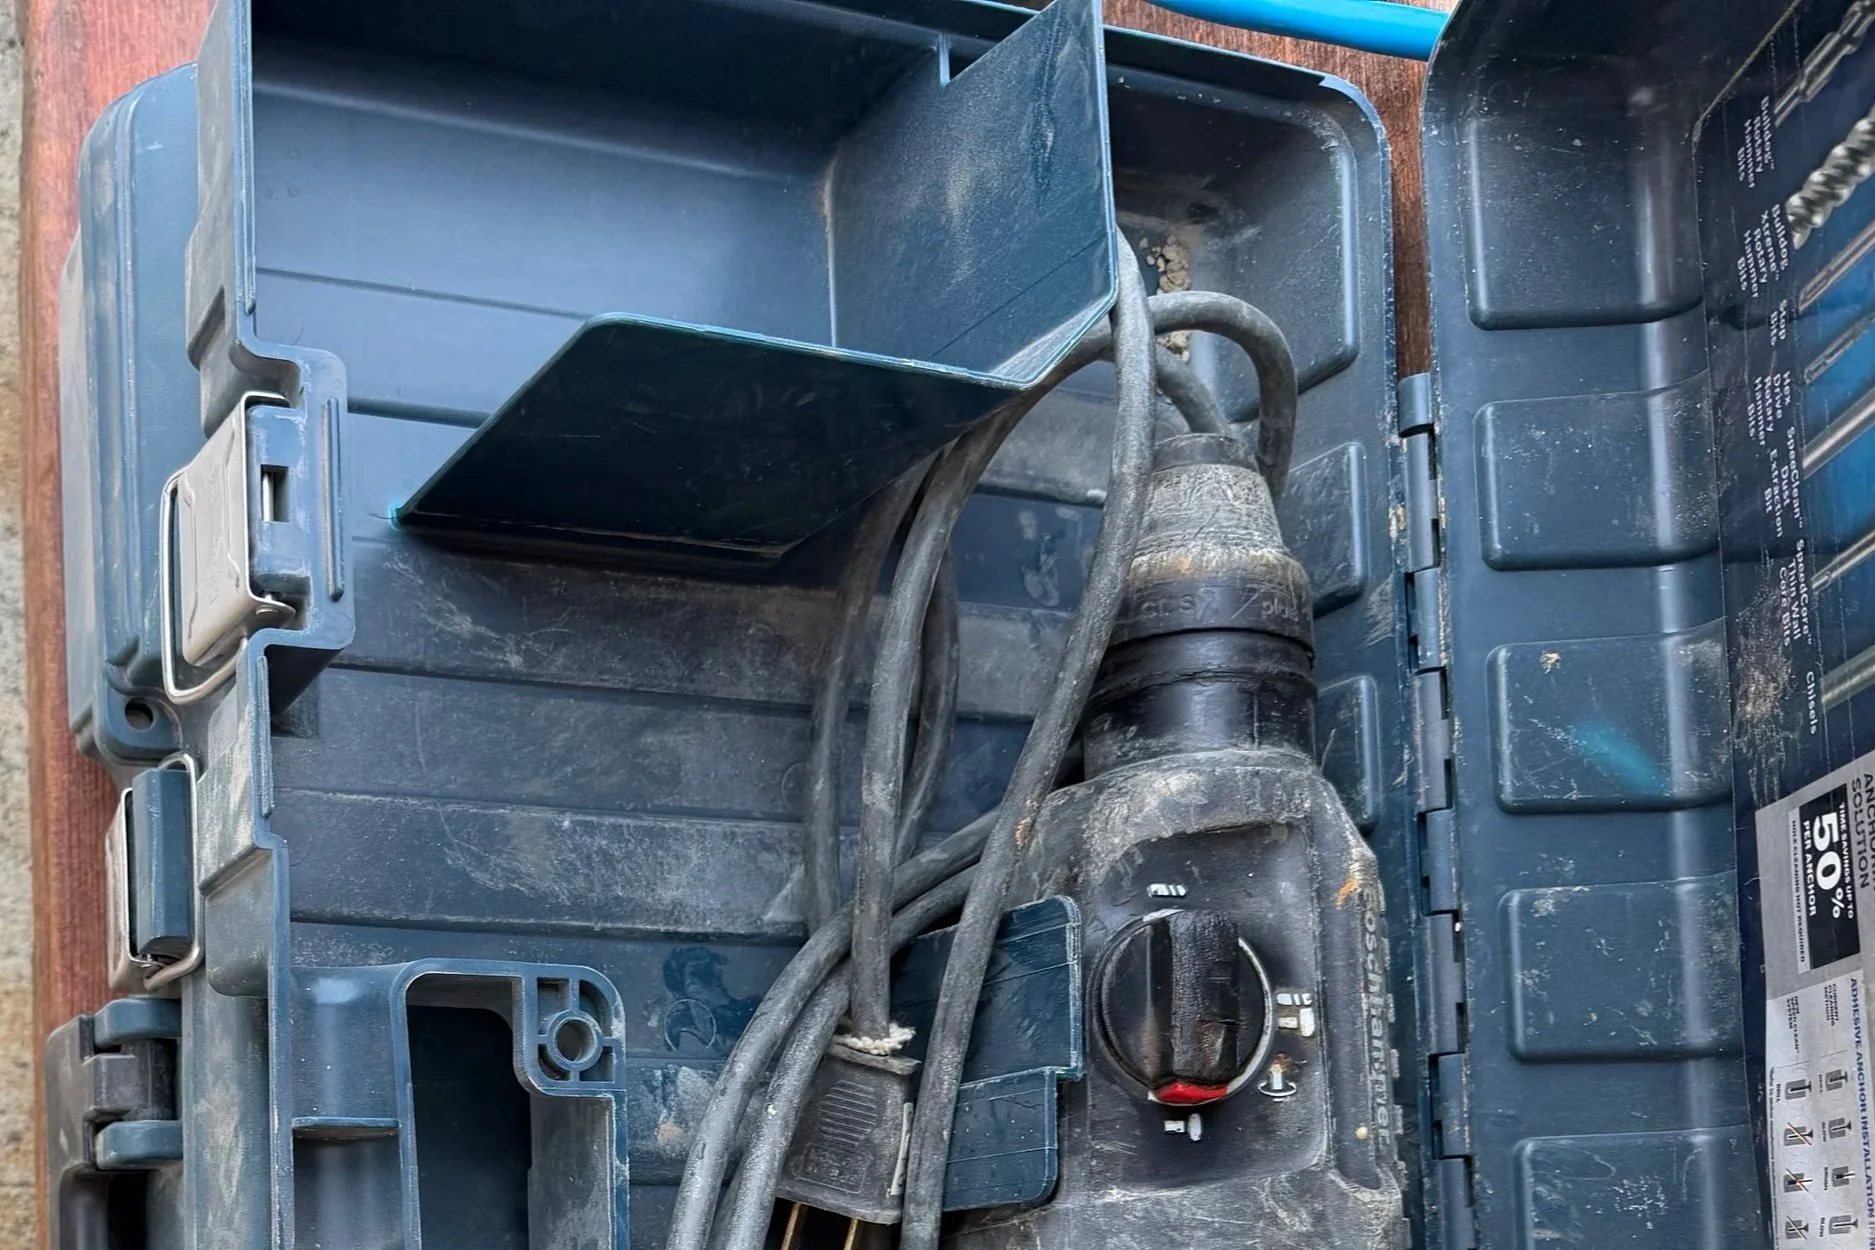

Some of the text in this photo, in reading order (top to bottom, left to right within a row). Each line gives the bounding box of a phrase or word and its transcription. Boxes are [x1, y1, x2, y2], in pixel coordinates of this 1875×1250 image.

[1737, 147, 1746, 181] Bits
[1744, 119, 1756, 188] Hammer
[1752, 116, 1763, 173] Rotary
[1744, 230, 1758, 298] Hammer
[1752, 228, 1768, 284] Rotary
[1772, 204, 1790, 271] Bulldog
[1737, 256, 1747, 291] Bits
[1770, 310, 1778, 346] Bits
[1778, 300, 1788, 340] Stop
[1754, 376, 1766, 446] Hammer
[1764, 376, 1774, 432] Rotary
[1773, 374, 1783, 419] Drive
[1782, 371, 1792, 406] Hex
[1748, 404, 1756, 438] Bits
[1764, 488, 1772, 513] Bit
[1770, 449, 1783, 538] Extraction
[1781, 466, 1790, 506] Dust
[1780, 567, 1791, 646] Core Bits
[1788, 558, 1800, 640] Thin Wall
[1806, 672, 1818, 734] Chisels
[1814, 812, 1845, 918] 50%
[1838, 802, 1854, 919] TIME SAVINGS UP TO
[1852, 778, 1870, 889] SOLUTION
[1803, 820, 1816, 916] PER ANCHOR
[1792, 847, 1800, 892] CLEANING
[1796, 916, 1805, 962] REQUIRED
[1850, 978, 1860, 1049] ADHESIVE
[1856, 1052, 1866, 1114] ANCHOR
[1860, 1116, 1874, 1218] INSTALLATION
